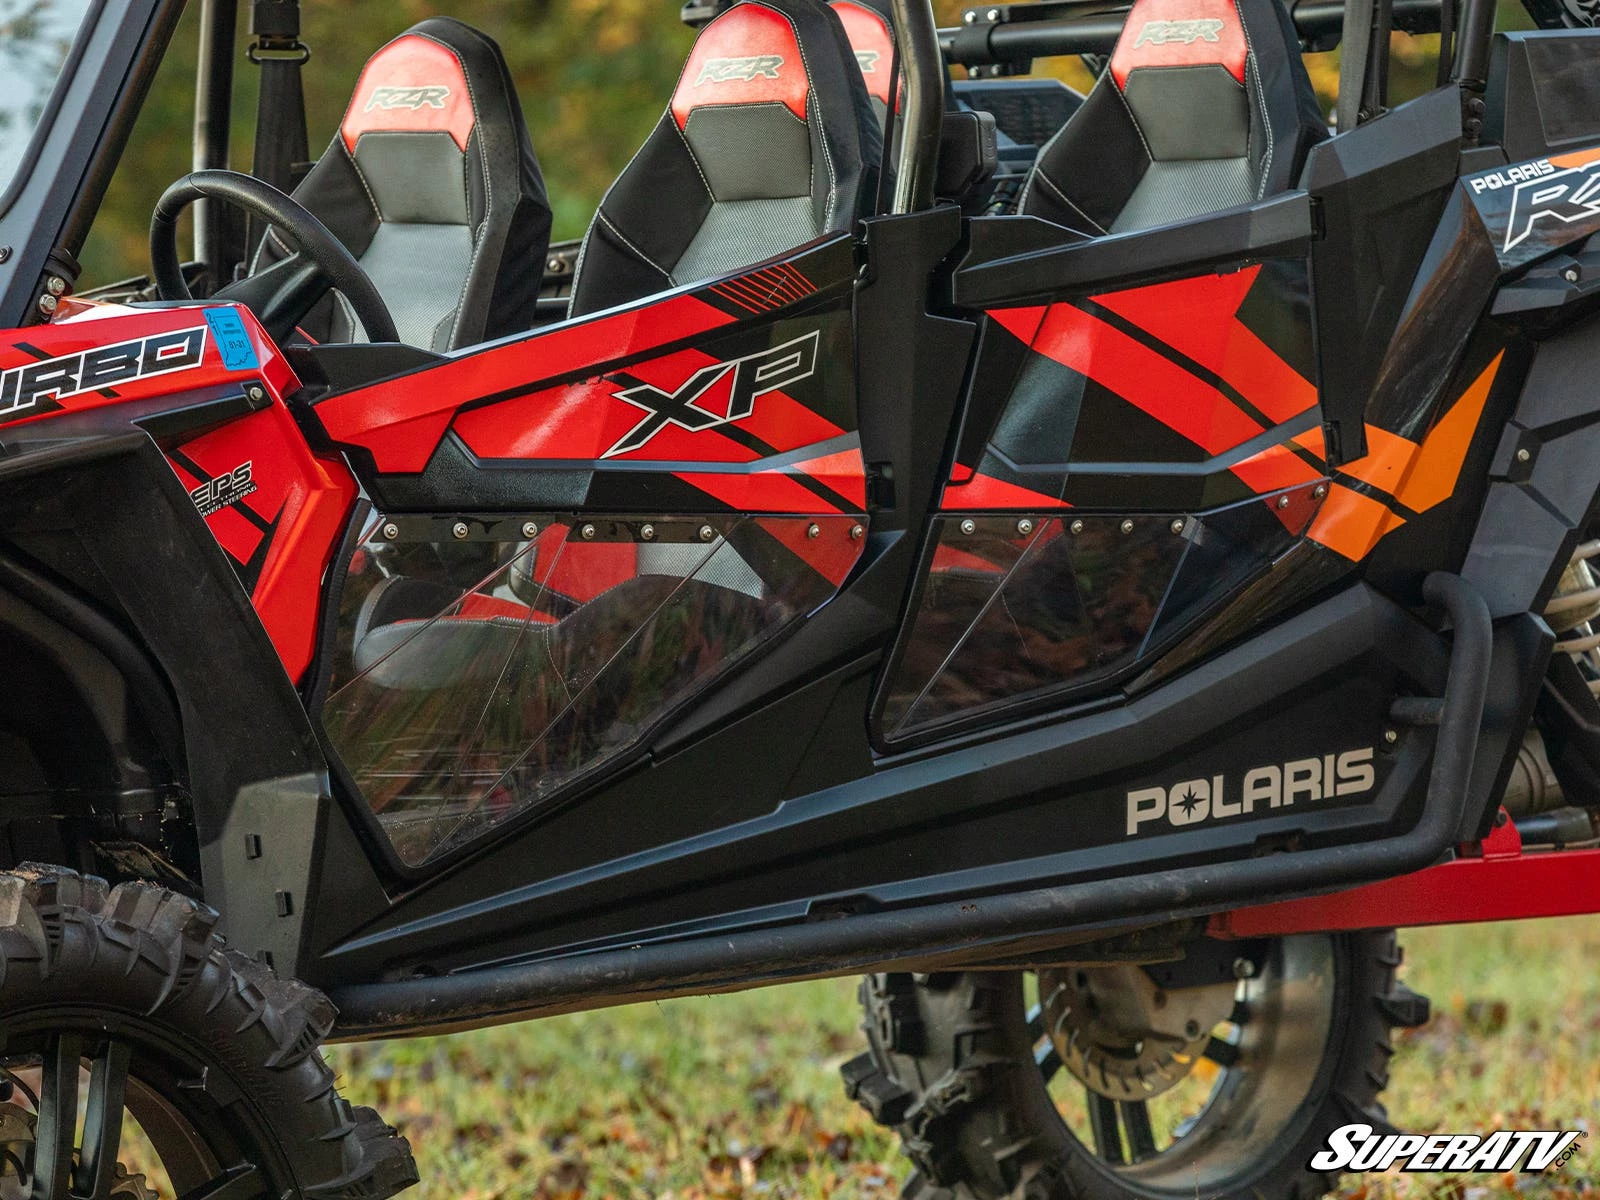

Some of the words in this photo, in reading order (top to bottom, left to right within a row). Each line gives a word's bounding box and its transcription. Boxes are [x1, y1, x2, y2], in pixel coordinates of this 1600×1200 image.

[1133, 18, 1224, 49] RZR
[694, 54, 785, 87] RZR
[363, 86, 451, 113] RZR
[1470, 159, 1555, 194] POLARIS
[599, 330, 820, 459] XP
[190, 460, 252, 508] EPS
[1126, 747, 1375, 836] POLARIS
